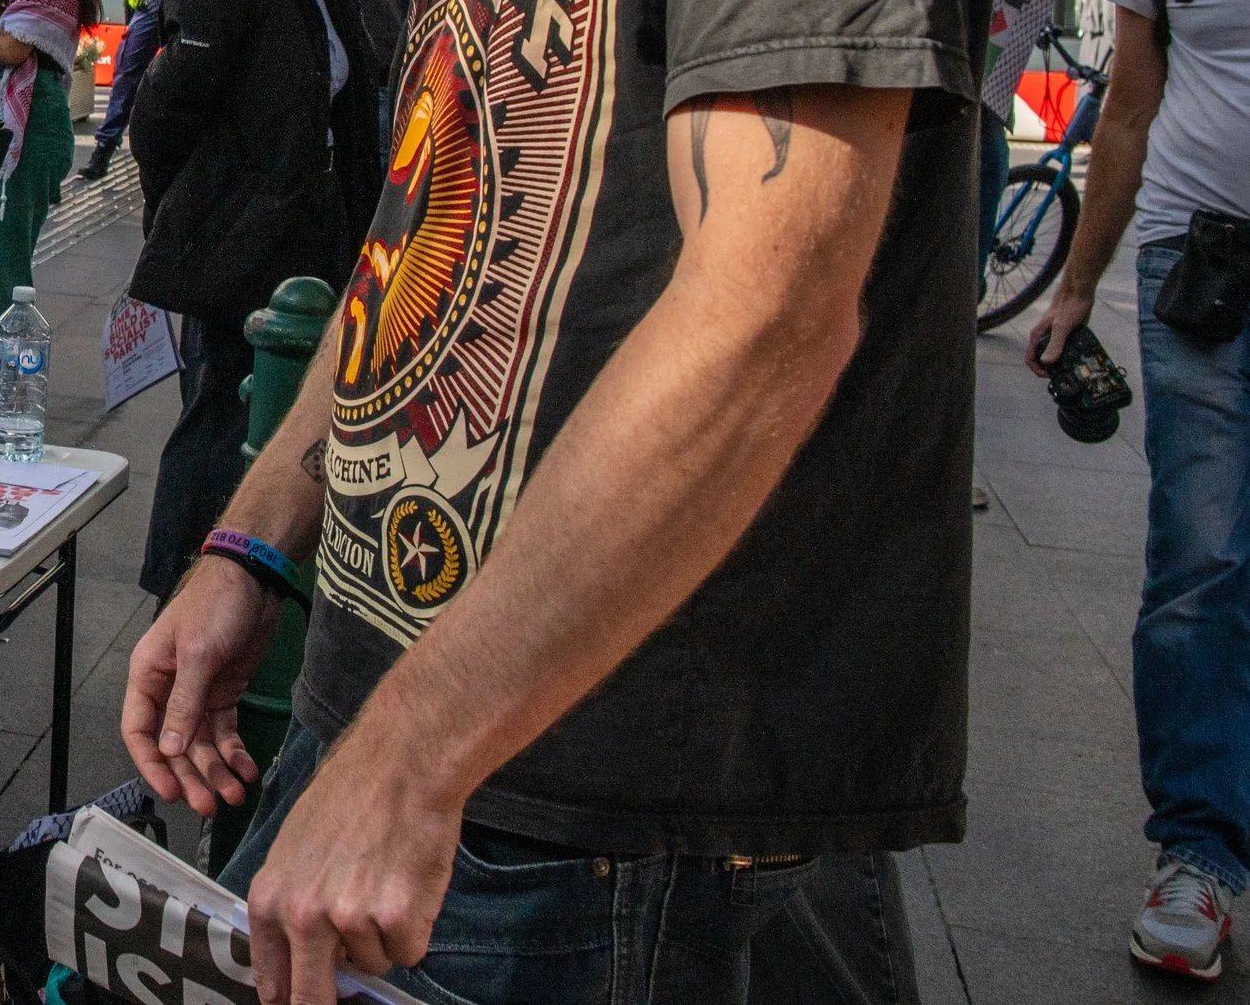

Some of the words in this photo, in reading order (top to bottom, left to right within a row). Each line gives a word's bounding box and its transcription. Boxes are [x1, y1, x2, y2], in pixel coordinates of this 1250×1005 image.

[104, 309, 157, 361] SOCIALIST
[113, 329, 147, 364] PARTY
[327, 442, 391, 485] ACHINE
[210, 531, 227, 542] 812
[228, 534, 251, 549] 670
[250, 543, 277, 562] 1800
